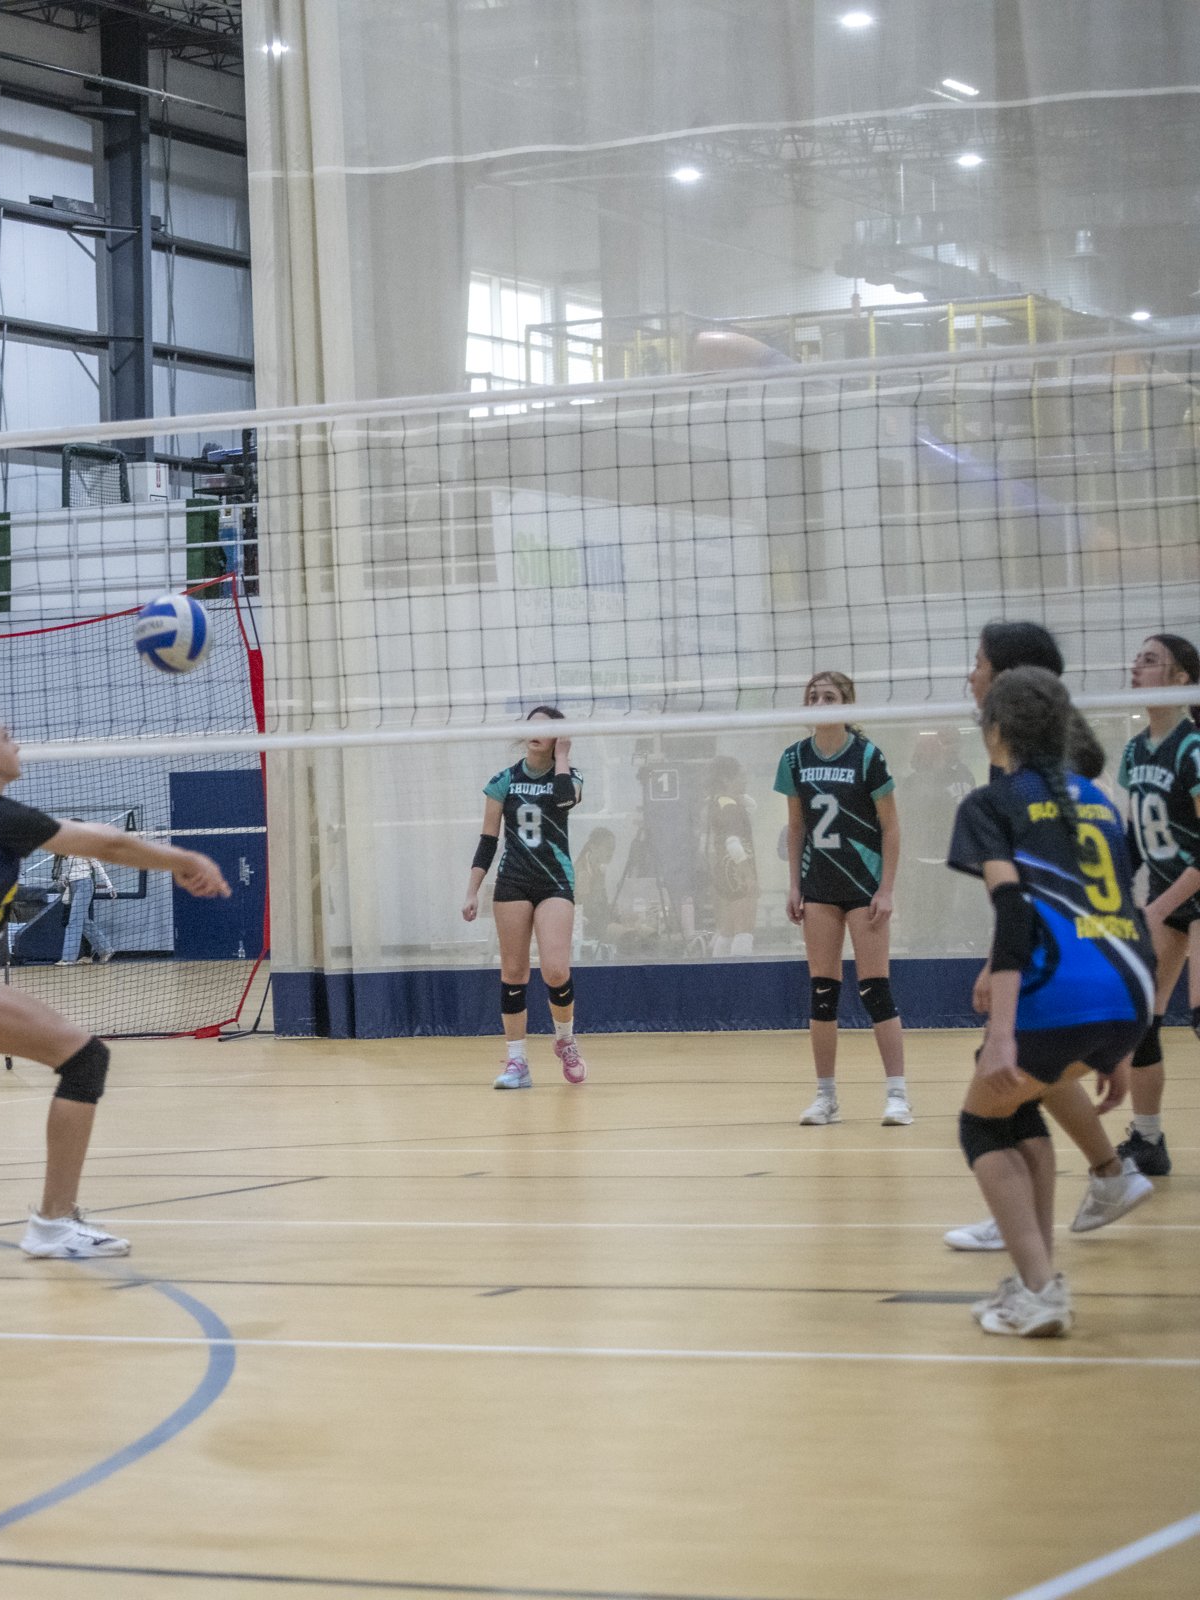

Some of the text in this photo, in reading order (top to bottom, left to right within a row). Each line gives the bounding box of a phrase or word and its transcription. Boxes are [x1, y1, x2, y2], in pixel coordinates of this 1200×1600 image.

[657, 773, 668, 792] 1
[800, 767, 855, 783] THUNDER
[509, 782, 553, 796] THUNDER
[517, 803, 542, 848] 8
[810, 794, 841, 849] 2
